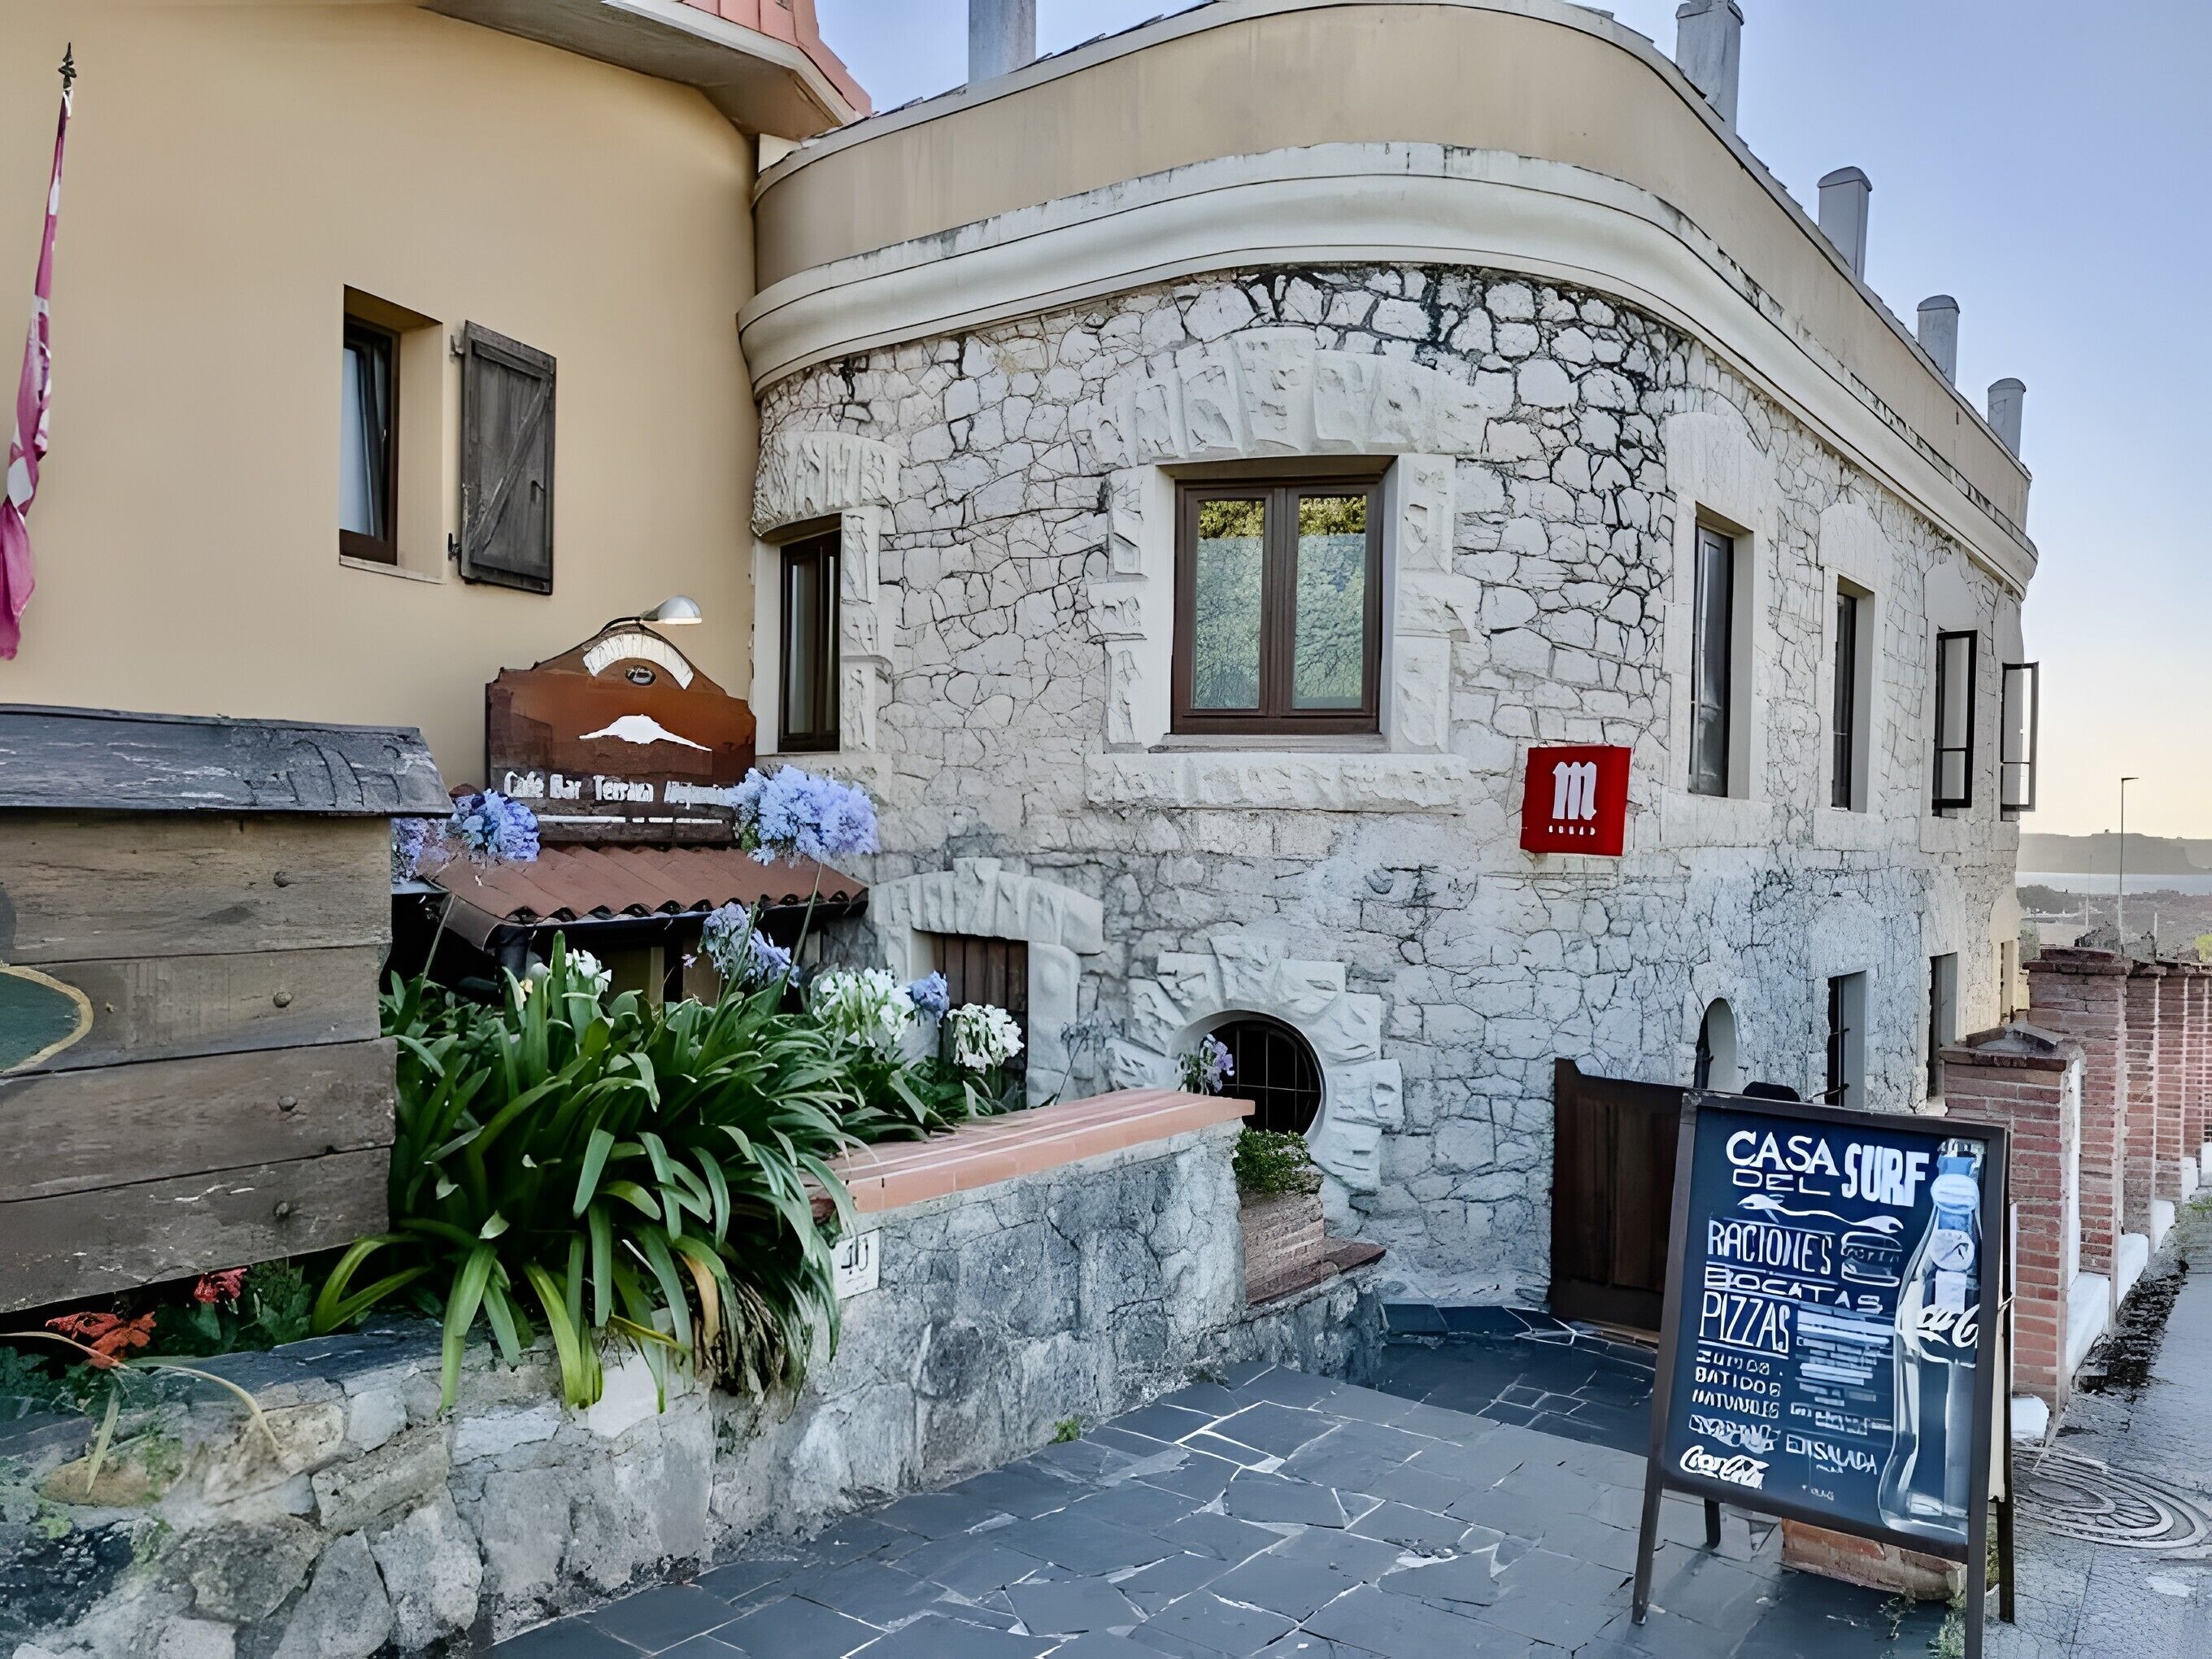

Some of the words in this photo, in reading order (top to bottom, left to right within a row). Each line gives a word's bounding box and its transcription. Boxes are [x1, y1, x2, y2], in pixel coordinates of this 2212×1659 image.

[1726, 1130, 1840, 1176] CASA
[1841, 1142, 1930, 1207] SURF
[1732, 1168, 1831, 1196] DEL
[1708, 1219, 1832, 1275] RACIONES
[1705, 1265, 1883, 1314] BOCATAS
[1699, 1291, 1791, 1354] PIZZAS
